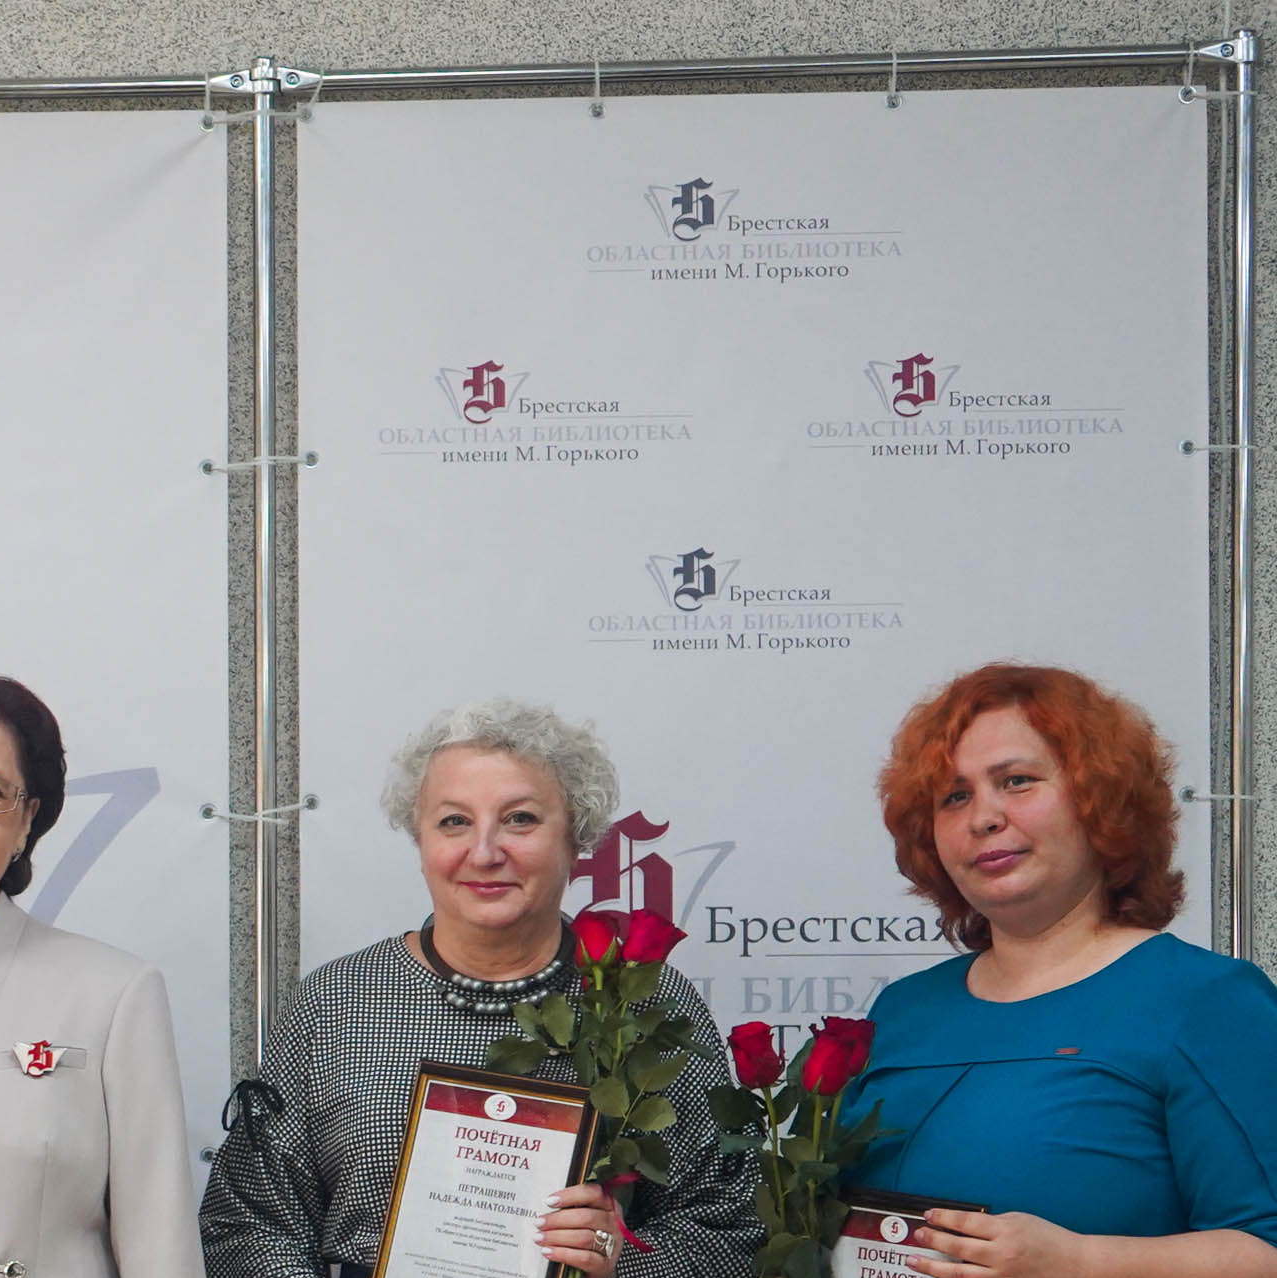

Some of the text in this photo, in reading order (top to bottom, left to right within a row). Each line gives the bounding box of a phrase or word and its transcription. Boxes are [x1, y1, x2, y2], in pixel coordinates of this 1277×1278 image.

[728, 215, 829, 236] Брестская
[586, 241, 902, 263] ОБЛАСТНАЯ БИБЛИОТЕКА
[651, 267, 717, 280] имени
[755, 262, 849, 283] Горького
[519, 398, 620, 419] Брестская
[949, 391, 1052, 412] Брестская
[378, 423, 693, 445] ОБЛАСТНАЯ БИБЛИОТЕКА
[807, 417, 1124, 439] ОБЛАСТНАЯ БИБЛИОТЕКА
[442, 449, 508, 463] имени
[546, 445, 639, 466] Горького
[871, 443, 937, 456] имени
[977, 438, 1071, 459] Горького
[729, 585, 831, 606] Брестская
[588, 611, 903, 632] ОБЛАСТНАЯ БИБЛИОТЕКА
[652, 637, 718, 650] имени
[757, 633, 851, 654] Горького
[455, 1126, 542, 1152] ПОЧЁТНАЯ
[457, 1146, 530, 1170] ГРАМОТА
[429, 1192, 472, 1207] НАДЕЖДА
[458, 1183, 516, 1200] ПЕТРАШЕВИЧ
